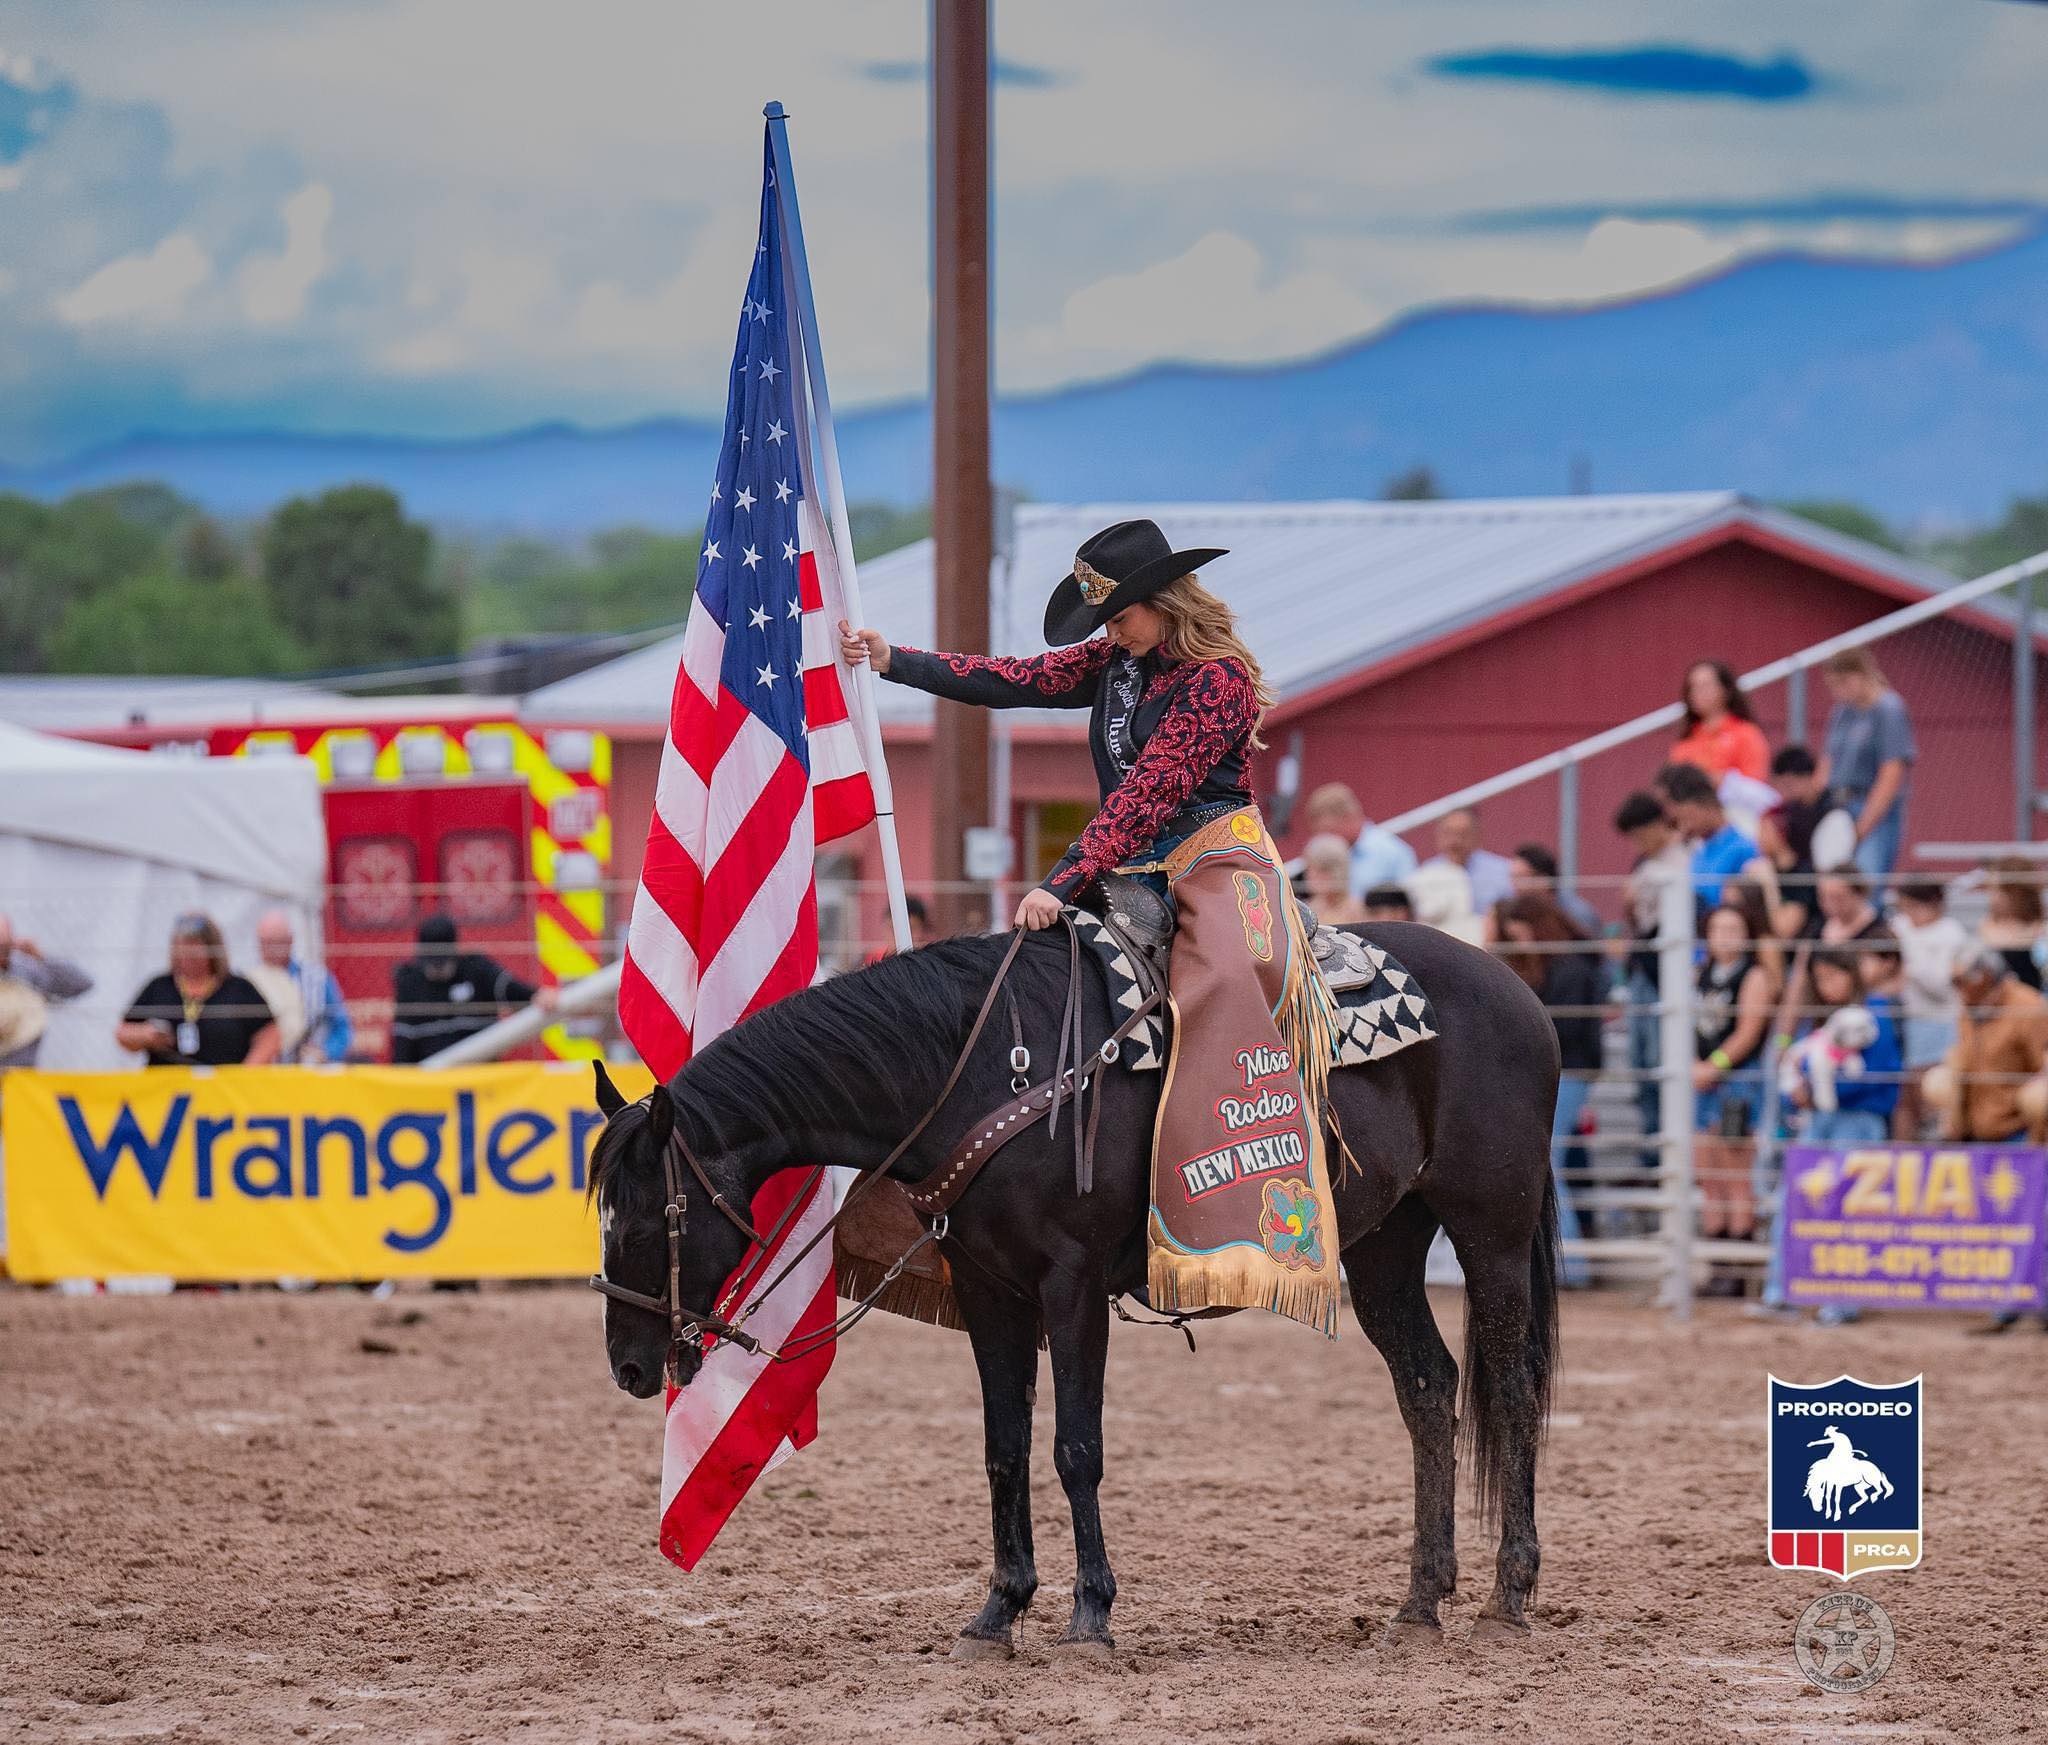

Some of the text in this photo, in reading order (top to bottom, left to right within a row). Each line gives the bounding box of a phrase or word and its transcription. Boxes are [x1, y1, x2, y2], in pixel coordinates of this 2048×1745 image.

[1237, 1045, 1291, 1086] Miss
[1220, 1089, 1298, 1130] Rodeo
[56, 1089, 606, 1254] Wrangler
[1181, 1131, 1305, 1195] NEW MEXICO
[1841, 1150, 1981, 1218] ZIA
